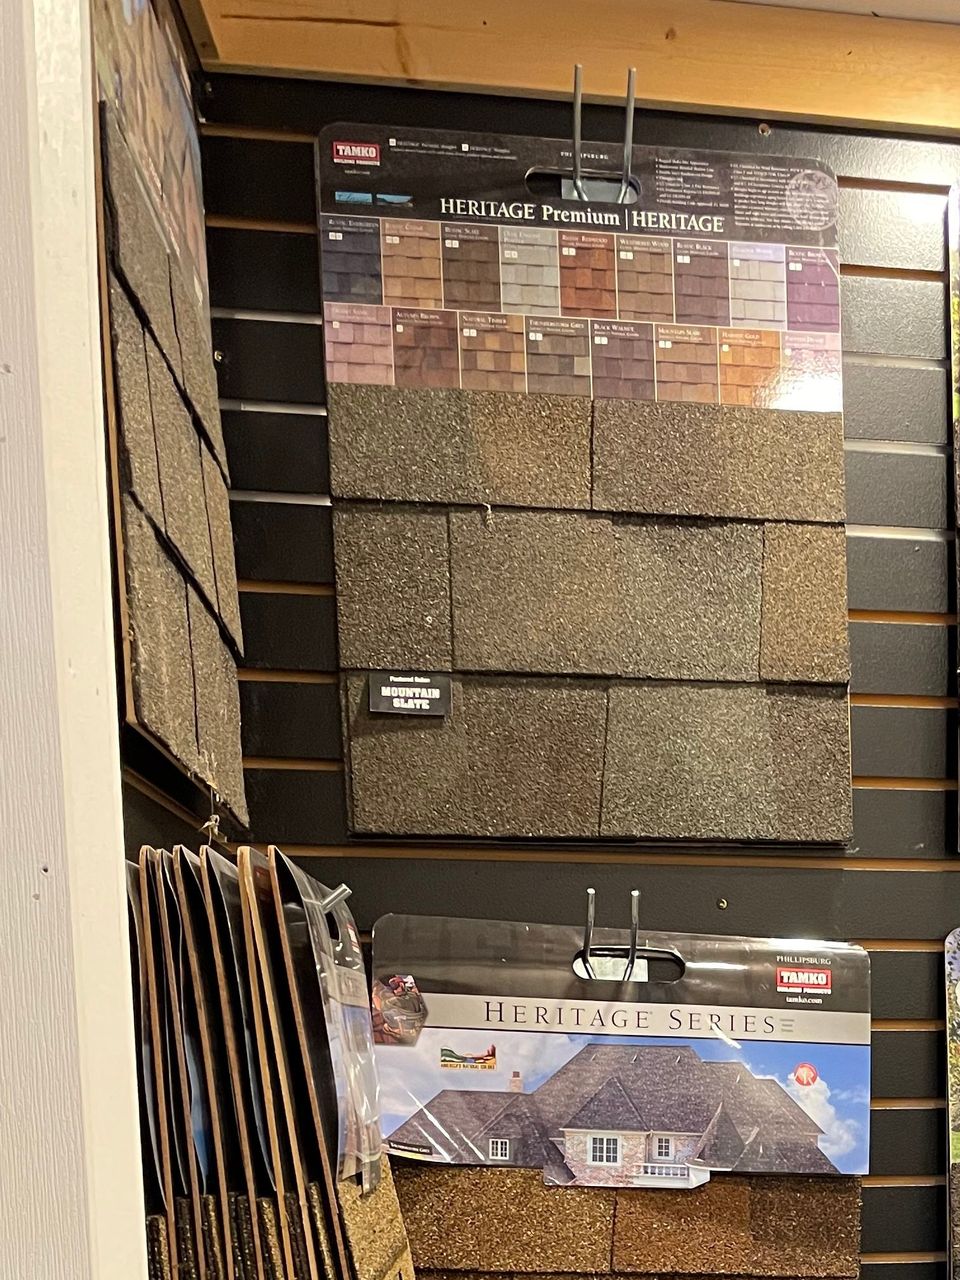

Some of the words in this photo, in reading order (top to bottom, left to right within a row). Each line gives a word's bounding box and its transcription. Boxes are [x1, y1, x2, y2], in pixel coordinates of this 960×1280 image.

[336, 145, 377, 158] TAMKO
[440, 198, 536, 220] HERITAGE
[541, 205, 620, 226] Premium
[632, 210, 724, 232] HERITAGE
[381, 686, 440, 699] MOUNTAIN
[392, 698, 430, 710] SLATE
[776, 955, 832, 965] PHILLIPSBURG
[780, 970, 827, 985] TAMKO
[484, 1001, 650, 1029] HERITAGE
[668, 1008, 776, 1035] SERIES
